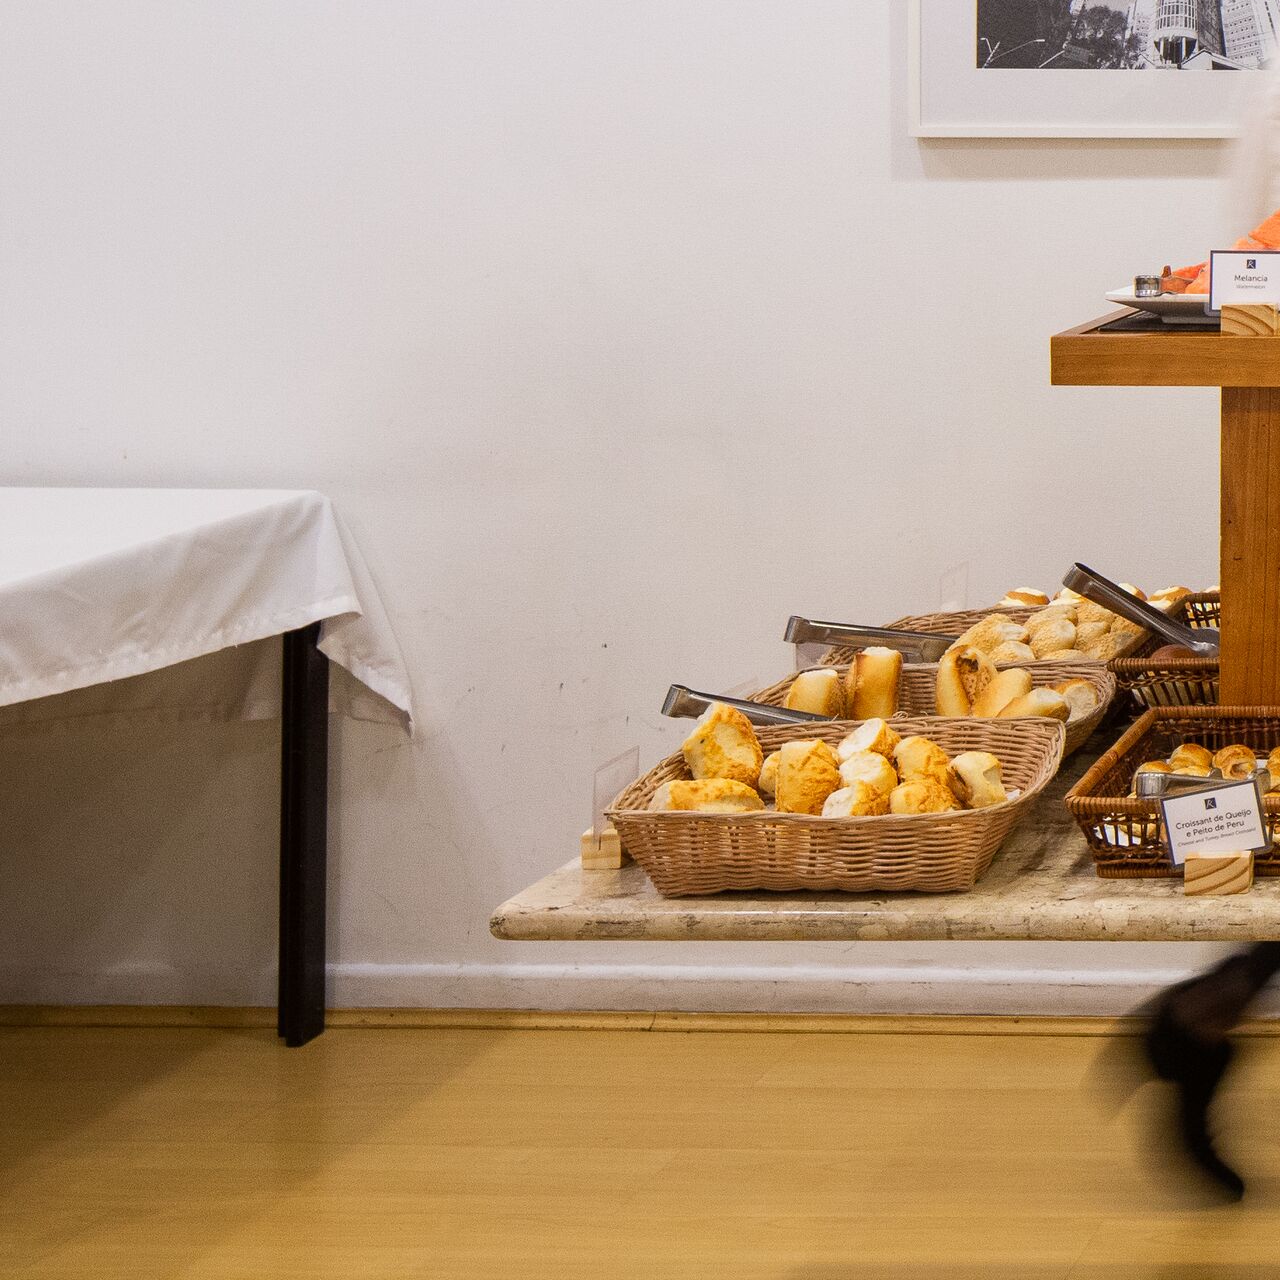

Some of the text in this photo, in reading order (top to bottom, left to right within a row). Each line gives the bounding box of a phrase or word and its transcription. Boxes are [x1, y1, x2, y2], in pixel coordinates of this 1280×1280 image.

[1175, 808, 1252, 830] Croissant de Queijo
[1192, 825, 1213, 837] Peito
[1214, 823, 1225, 832] de
